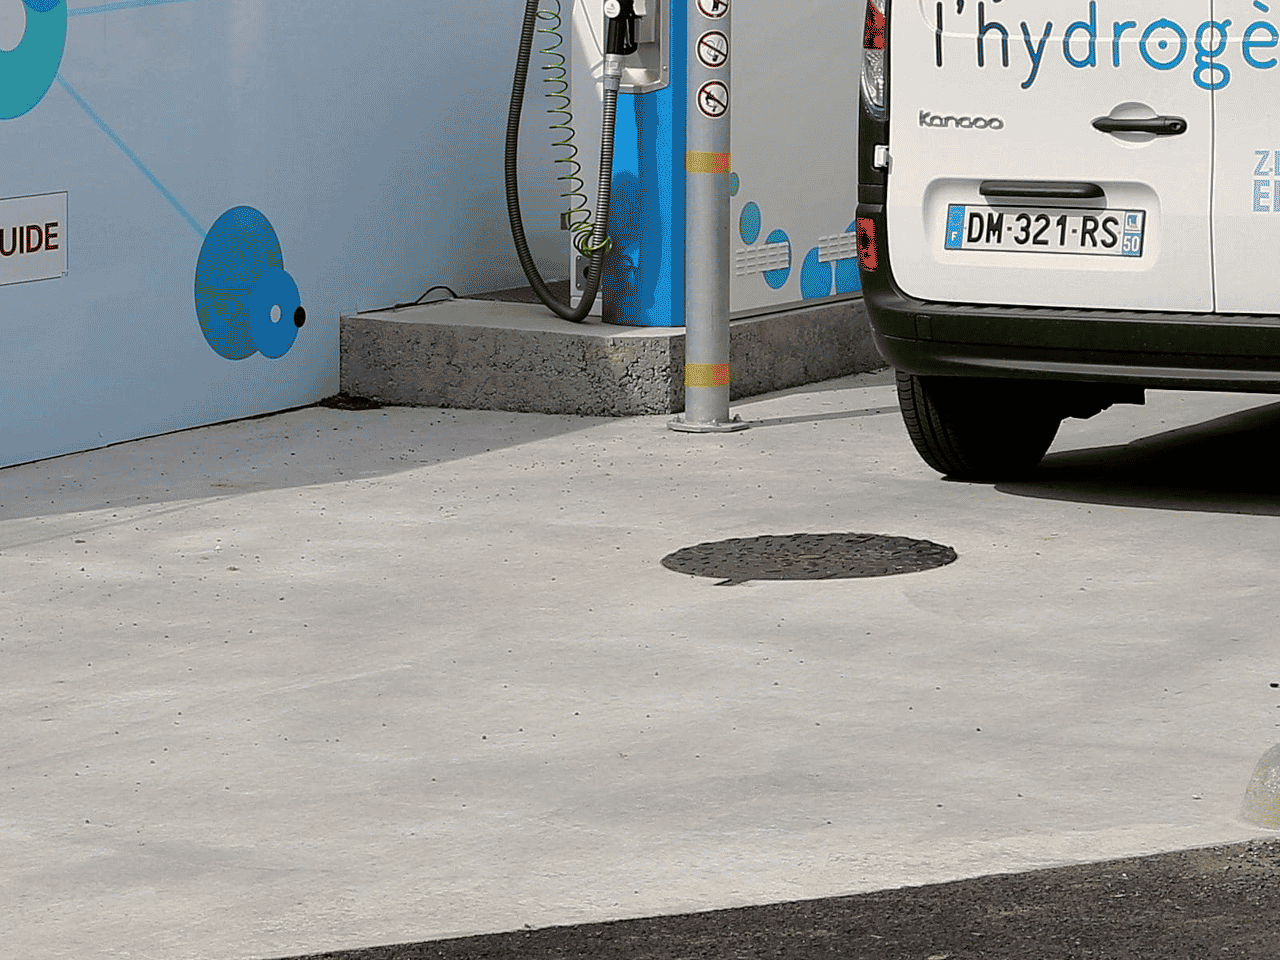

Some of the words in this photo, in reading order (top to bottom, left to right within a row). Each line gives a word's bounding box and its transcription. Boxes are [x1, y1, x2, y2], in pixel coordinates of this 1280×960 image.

[950, 231, 958, 242] F
[966, 211, 1119, 249] DM-321-RS
[1123, 235, 1140, 252] 50
